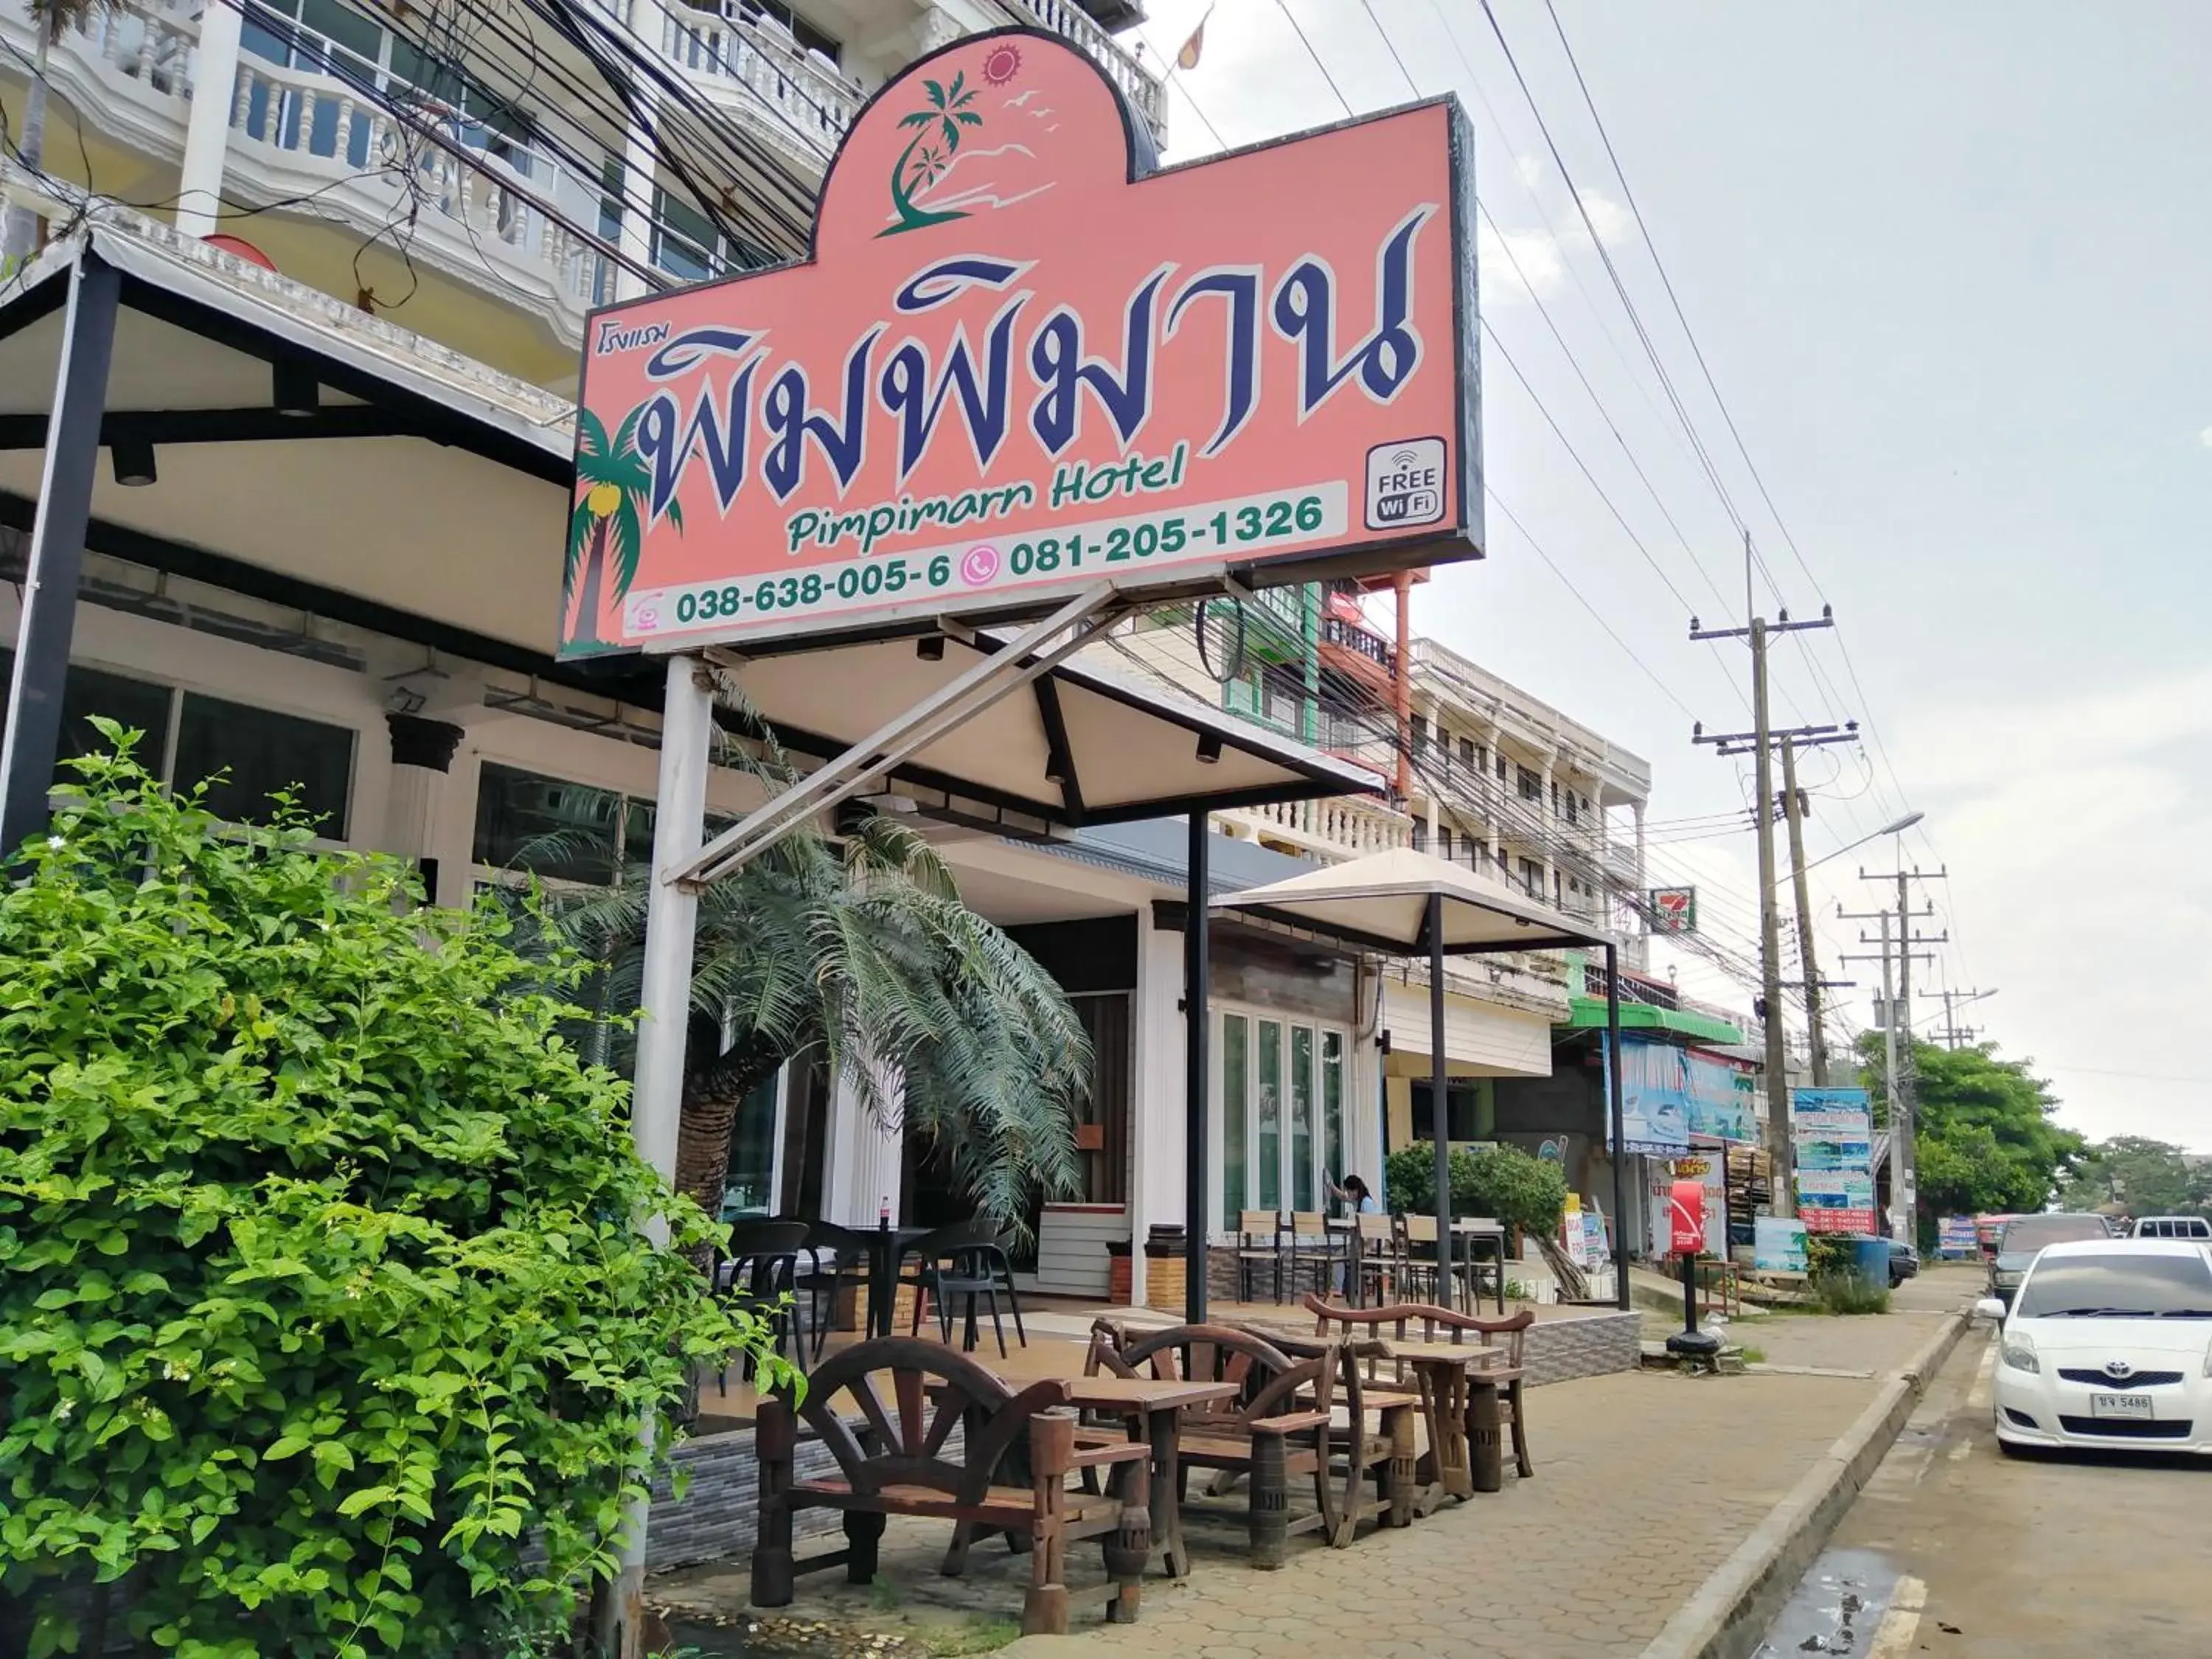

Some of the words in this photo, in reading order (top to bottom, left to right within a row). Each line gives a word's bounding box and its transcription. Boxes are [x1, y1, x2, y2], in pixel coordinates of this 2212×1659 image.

[597, 322, 671, 354] โรงแรม
[636, 207, 1433, 531] พิมพิมาน
[787, 484, 1034, 554] Pimpimarn
[1052, 444, 1186, 507] Hotel
[1378, 467, 1436, 493] FREE
[1009, 495, 1324, 576] 081-205-1326
[675, 555, 950, 623] 038-638-005-6
